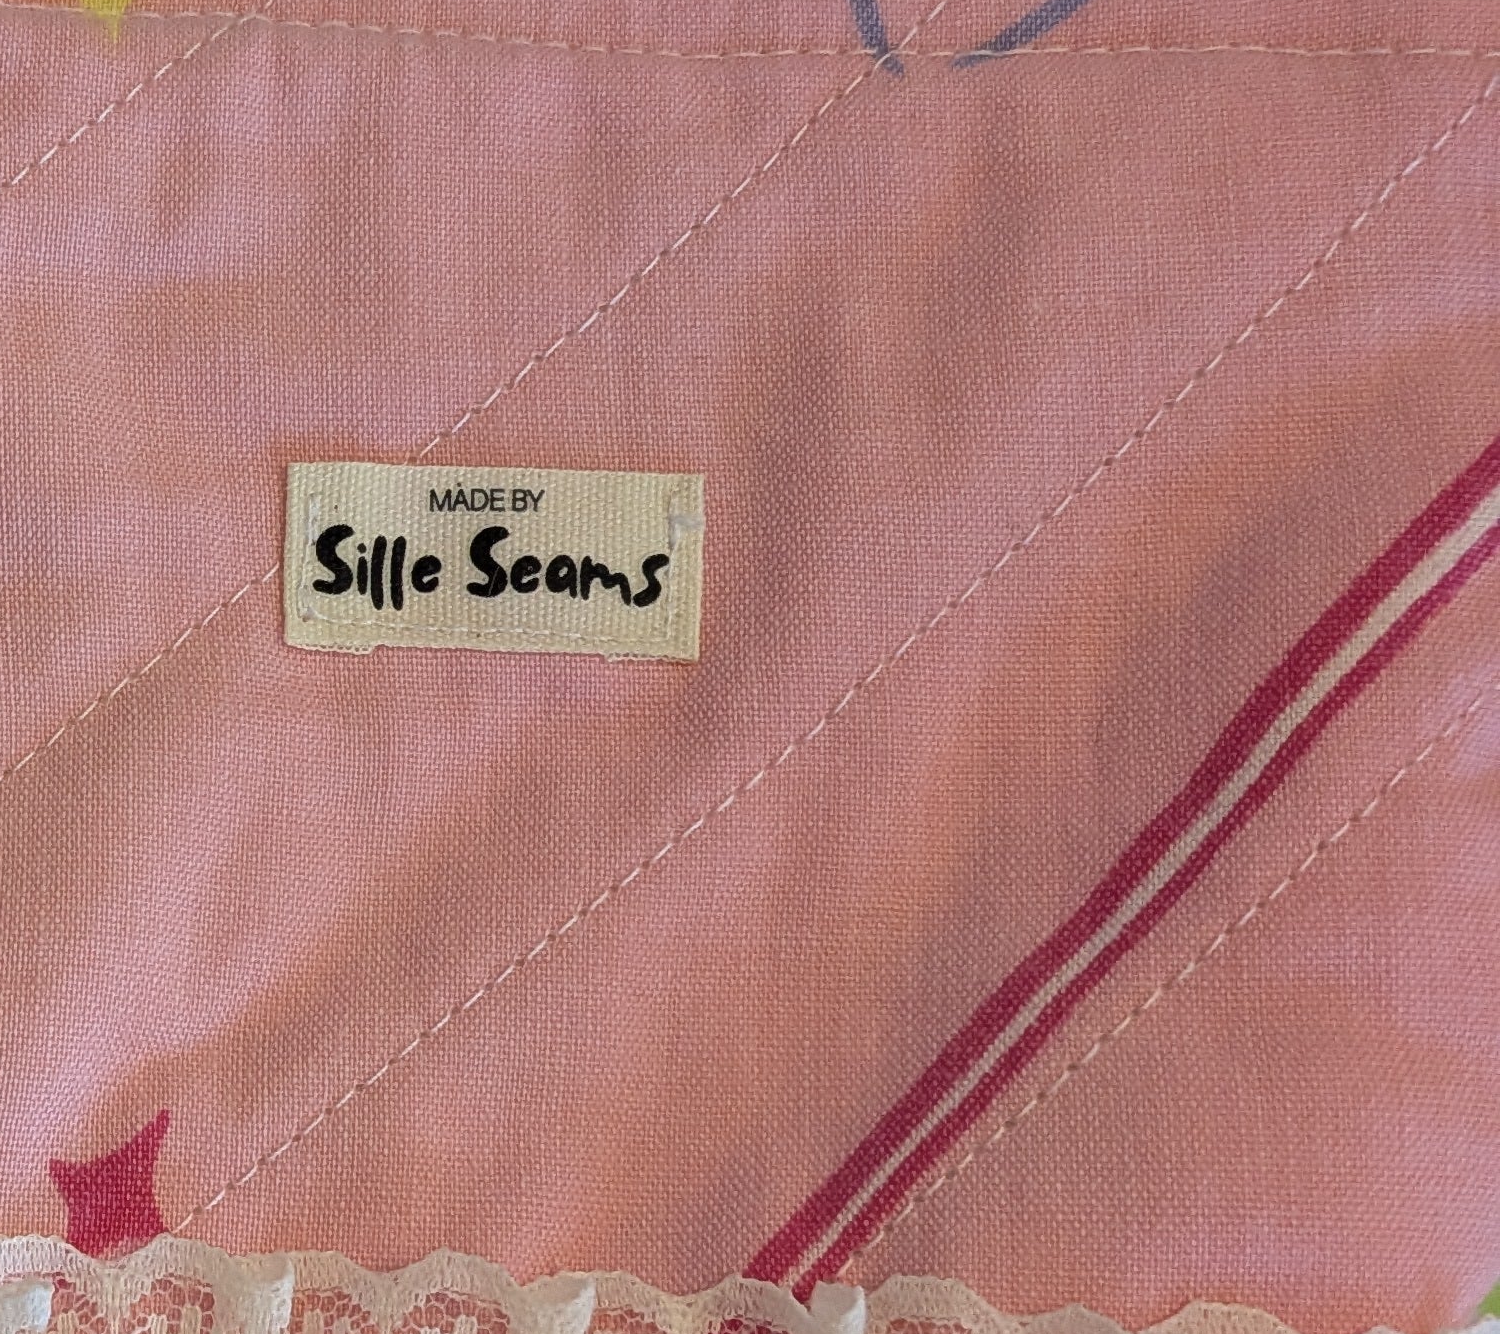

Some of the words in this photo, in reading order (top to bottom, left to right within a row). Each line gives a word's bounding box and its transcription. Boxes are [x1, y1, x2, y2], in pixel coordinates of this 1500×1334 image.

[428, 488, 505, 513] MADE
[511, 488, 545, 513] BY
[312, 523, 442, 611] Sille
[466, 525, 670, 608] Seams
